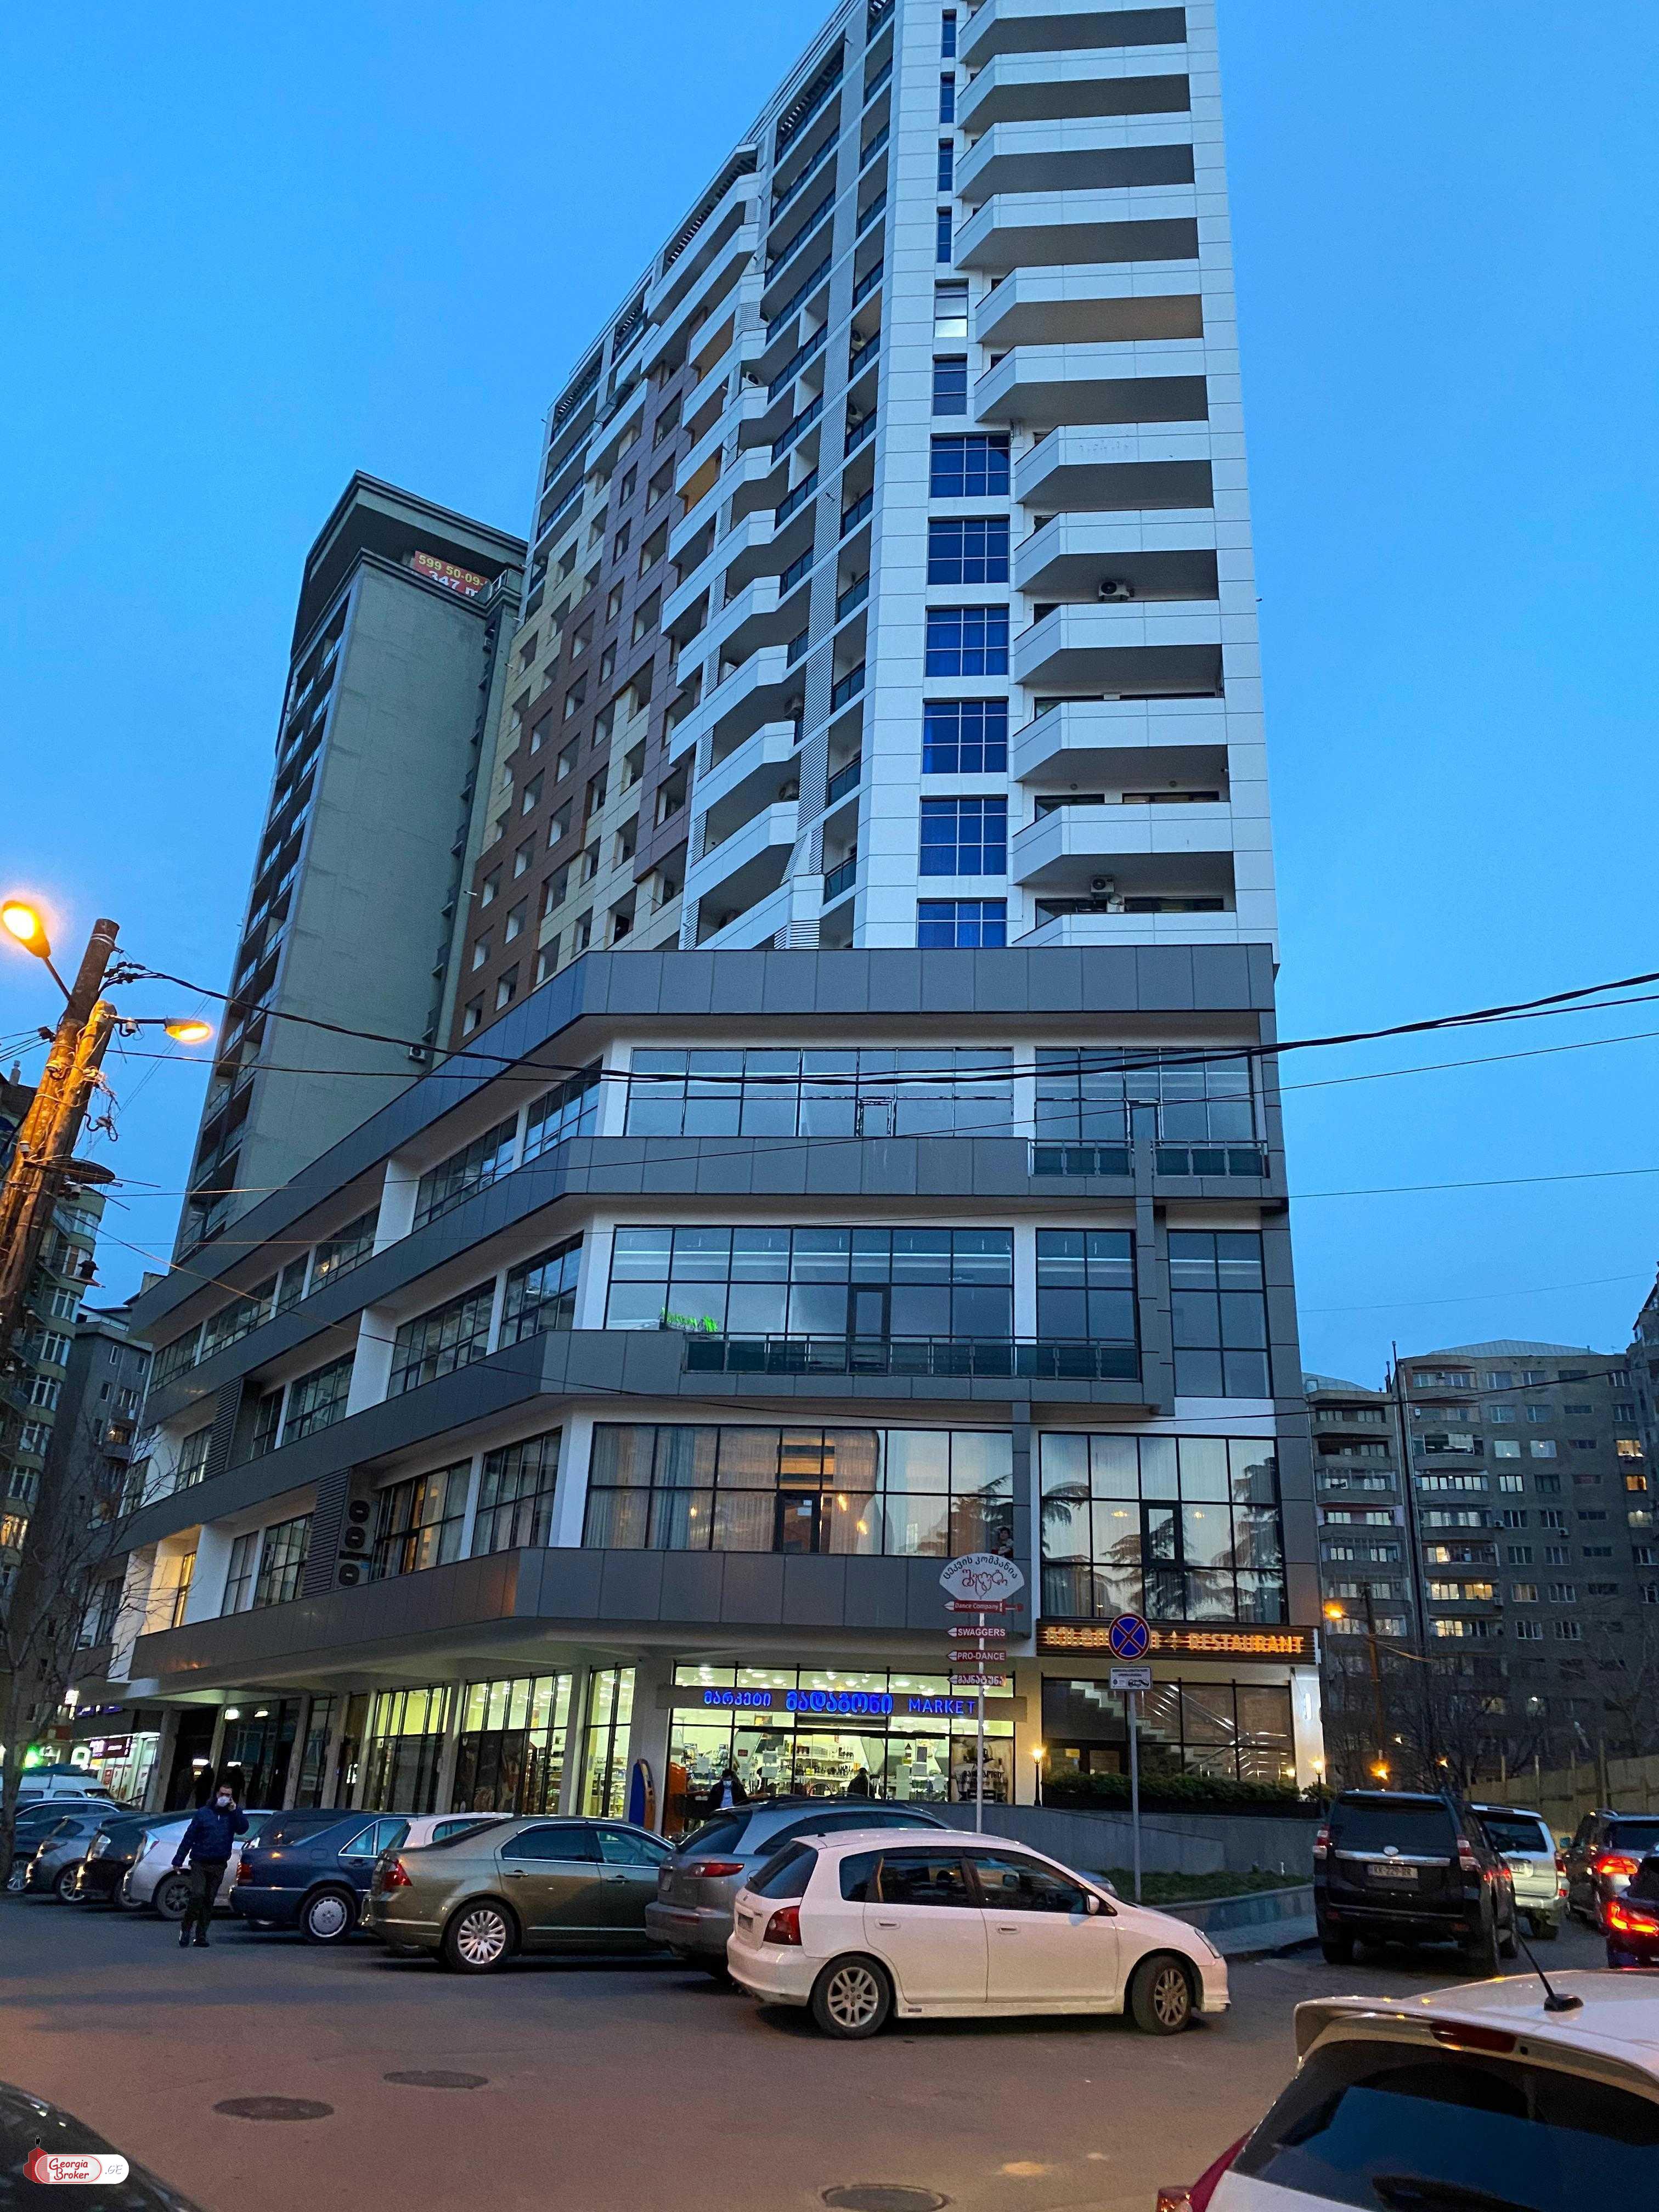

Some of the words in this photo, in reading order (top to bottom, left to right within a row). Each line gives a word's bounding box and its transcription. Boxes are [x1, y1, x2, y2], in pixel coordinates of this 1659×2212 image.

[419, 554, 442, 571] 599
[445, 566, 487, 586] 50-09-
[943, 1556, 973, 1579] ცეკვის
[975, 1555, 1018, 1579] კომპანია
[957, 1628, 1006, 1637] SWAGGERS
[1188, 1632, 1305, 1654] RESTAURANT
[957, 1652, 1006, 1661] PRO-DANCE
[704, 1690, 771, 1707] მარკეტი
[909, 1698, 976, 1714] MARKET
